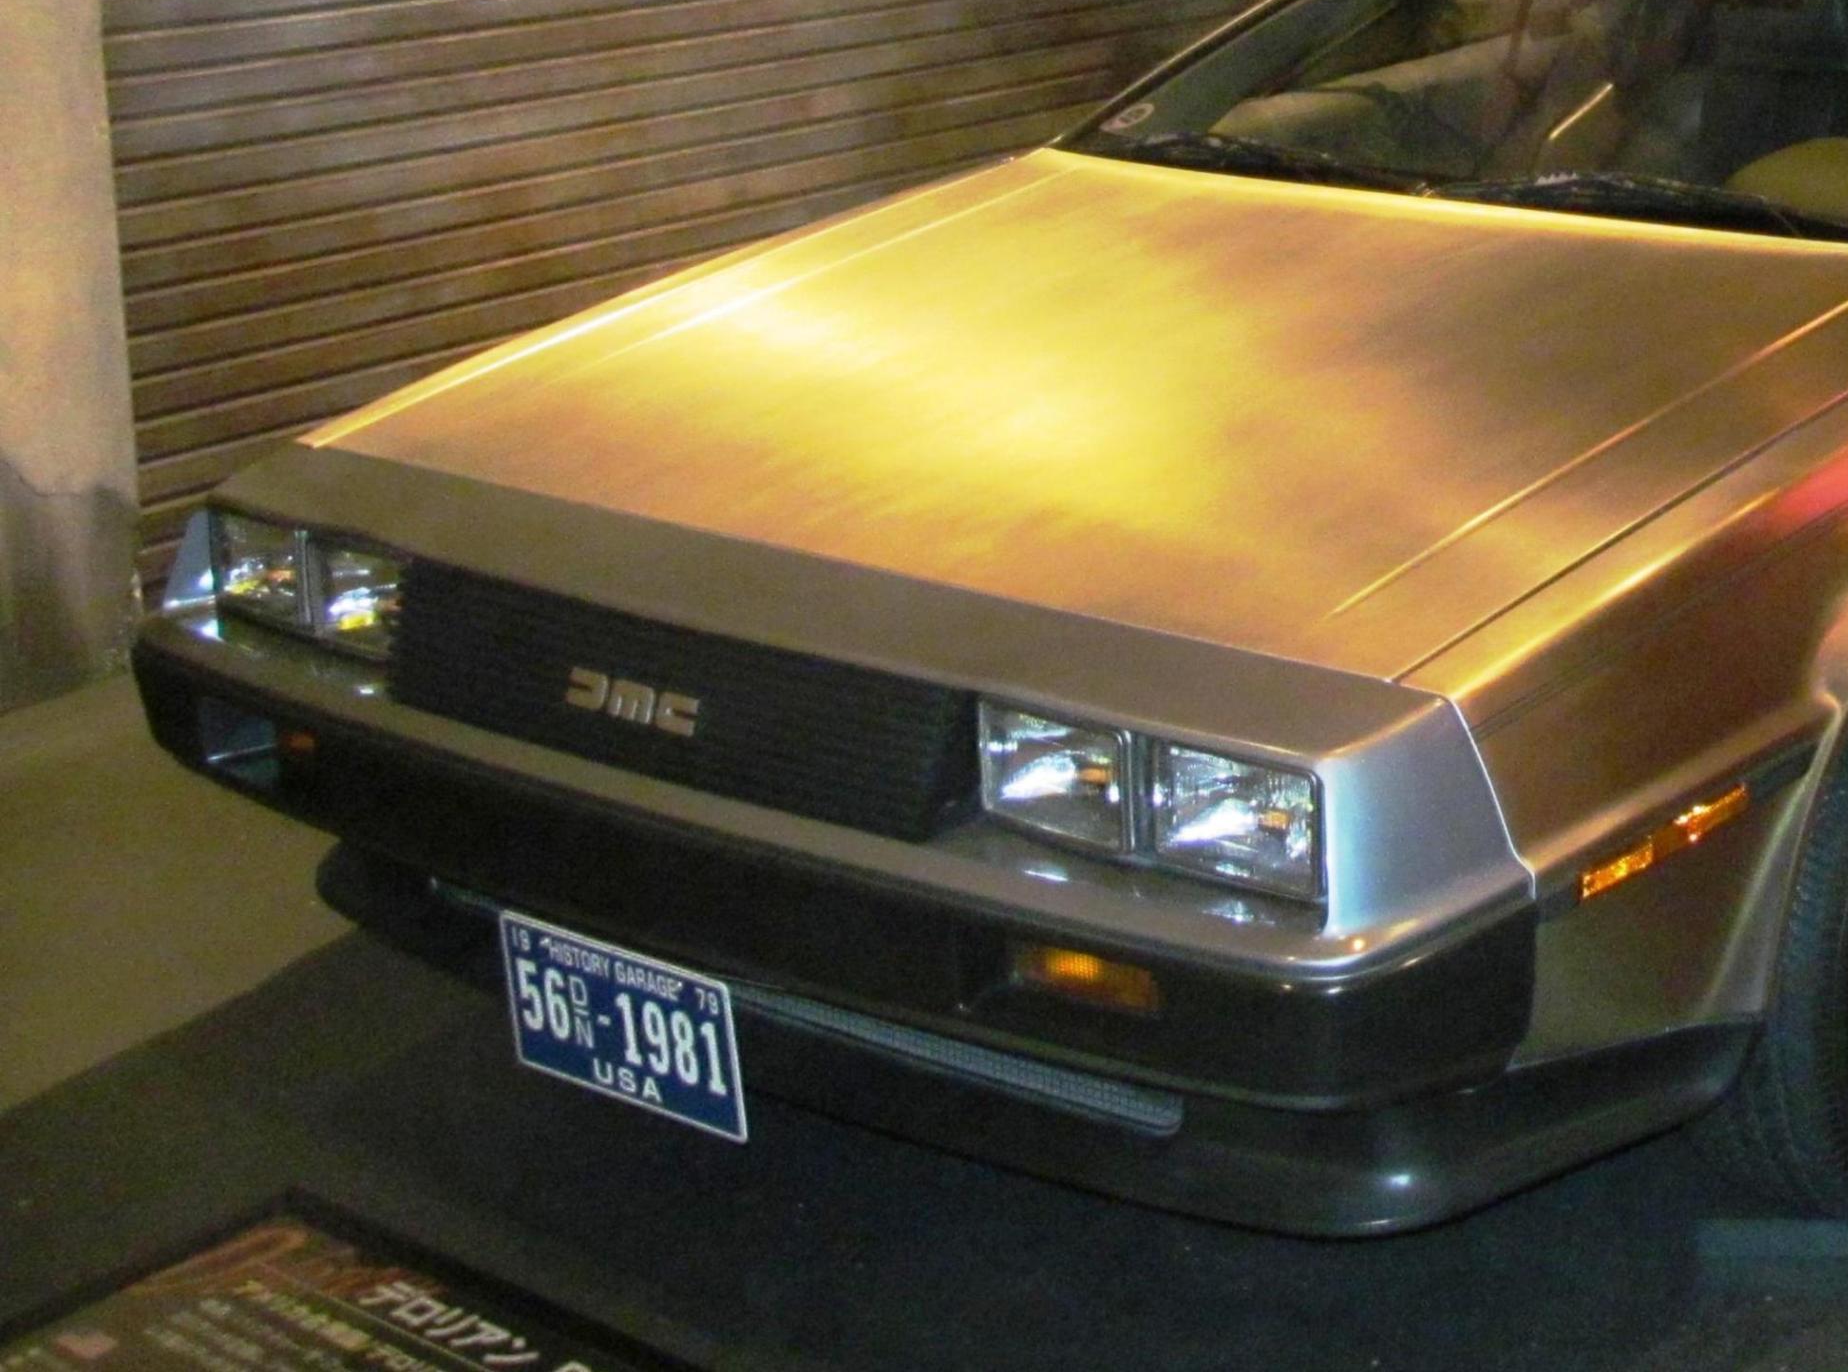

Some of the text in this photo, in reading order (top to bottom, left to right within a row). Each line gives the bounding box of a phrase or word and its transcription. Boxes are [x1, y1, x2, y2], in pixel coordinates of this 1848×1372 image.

[515, 957, 571, 1041] 56
[548, 939, 610, 978] HISTORY
[614, 960, 682, 1002] GARAGE
[592, 1057, 664, 1104] USA
